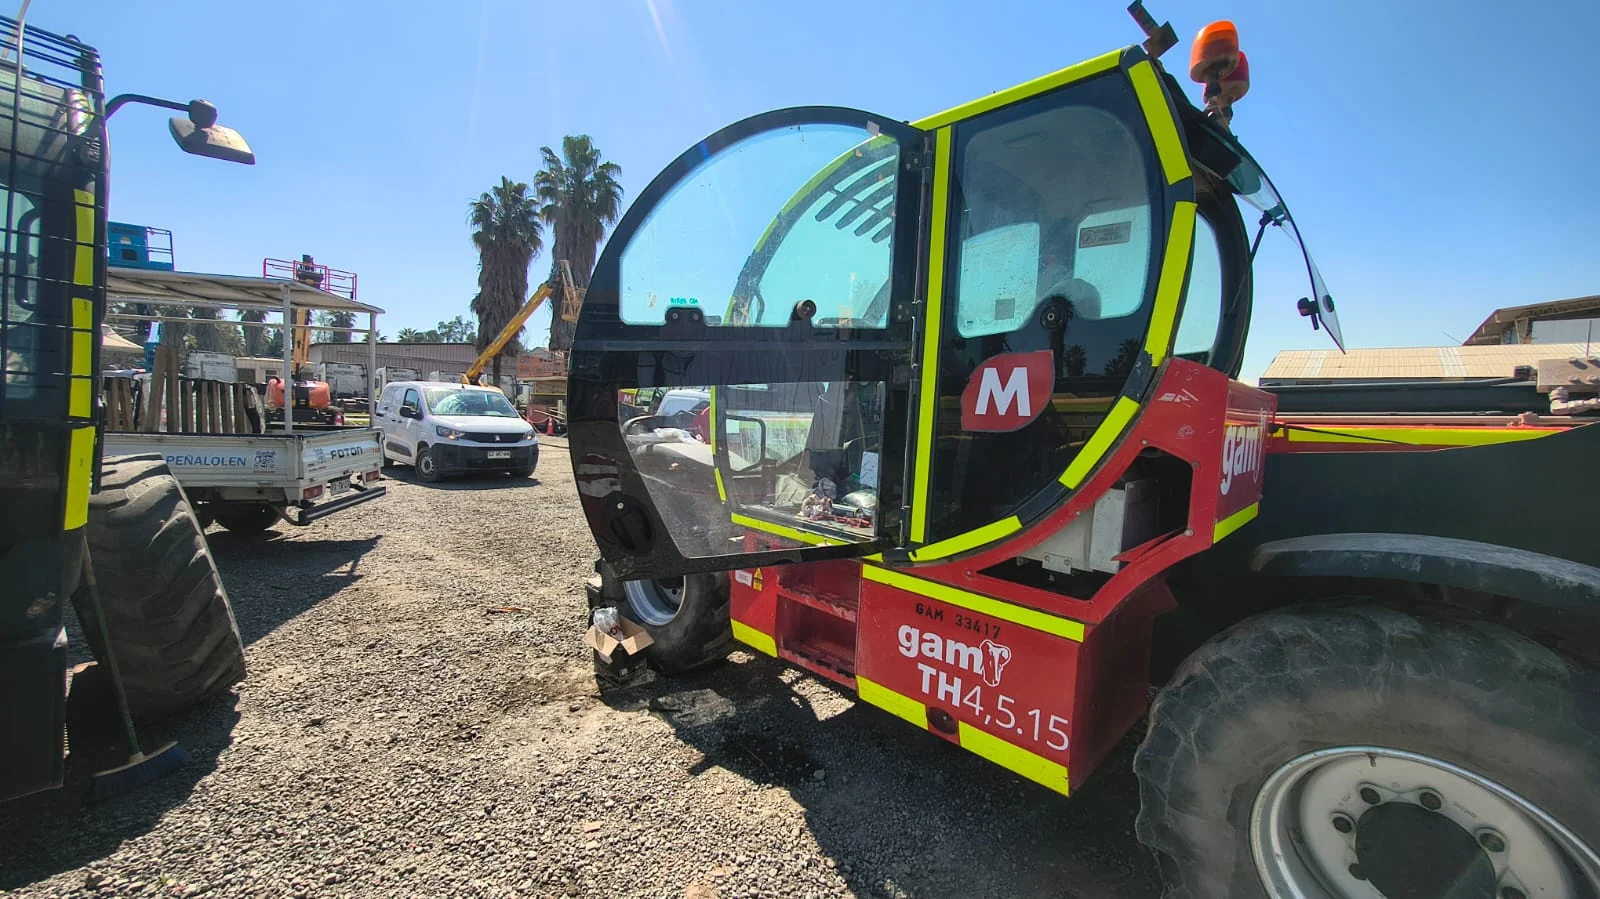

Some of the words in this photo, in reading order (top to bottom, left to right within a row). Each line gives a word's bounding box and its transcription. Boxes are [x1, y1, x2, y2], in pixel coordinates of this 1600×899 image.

[975, 367, 1031, 417] M
[330, 446, 363, 461] FOTON
[1220, 425, 1259, 496] gam
[915, 602, 944, 623] GAM
[897, 624, 983, 675] gam
